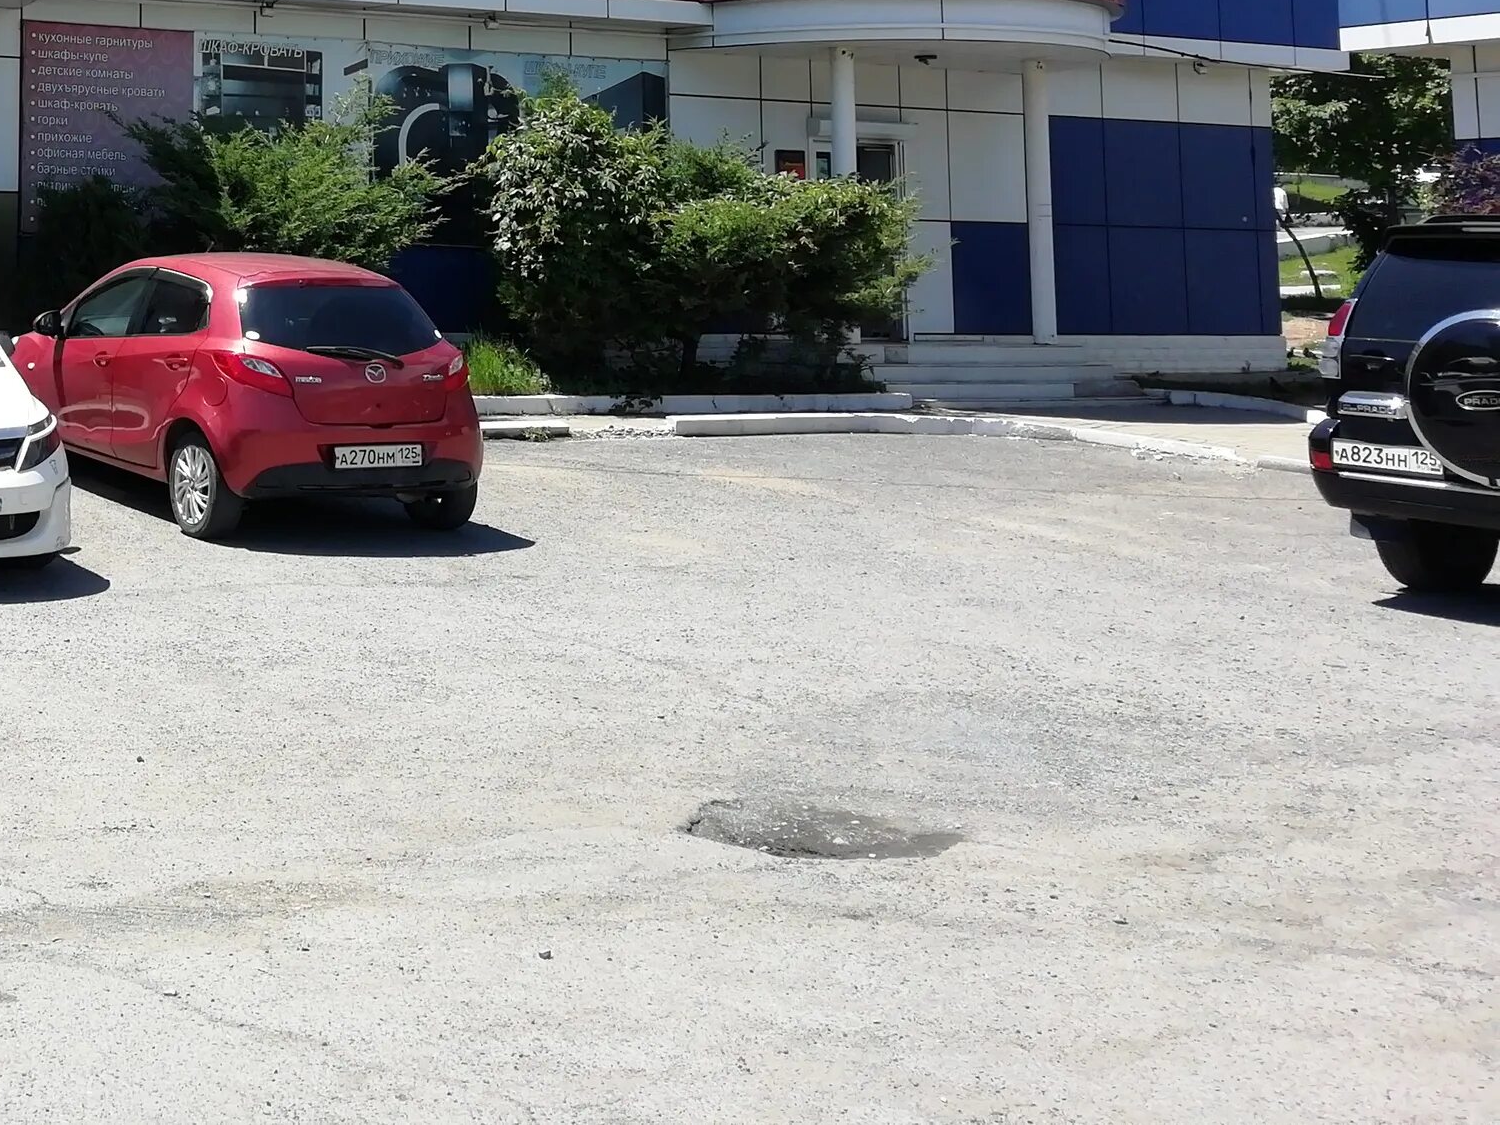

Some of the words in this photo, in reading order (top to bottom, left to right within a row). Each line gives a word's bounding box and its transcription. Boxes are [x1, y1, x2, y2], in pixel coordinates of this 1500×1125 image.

[38, 32, 92, 45] кухонные
[95, 37, 153, 50] гарнитуры
[198, 38, 305, 58] ШКАФ-КРОВАТЬ
[37, 49, 109, 63] шкафы-купе
[369, 49, 445, 70] ПРИХОЖИЕ
[37, 65, 82, 77] детские
[85, 68, 134, 80] комнаты
[37, 82, 119, 97] двухъярусные
[121, 85, 165, 99] кровати
[37, 99, 118, 113] шкаф-кровать
[37, 116, 69, 128] горки
[37, 131, 93, 144] прихожие
[37, 147, 85, 160] офисная
[87, 149, 127, 161] мебель
[398, 447, 418, 460] 125
[1411, 451, 1437, 467] 125
